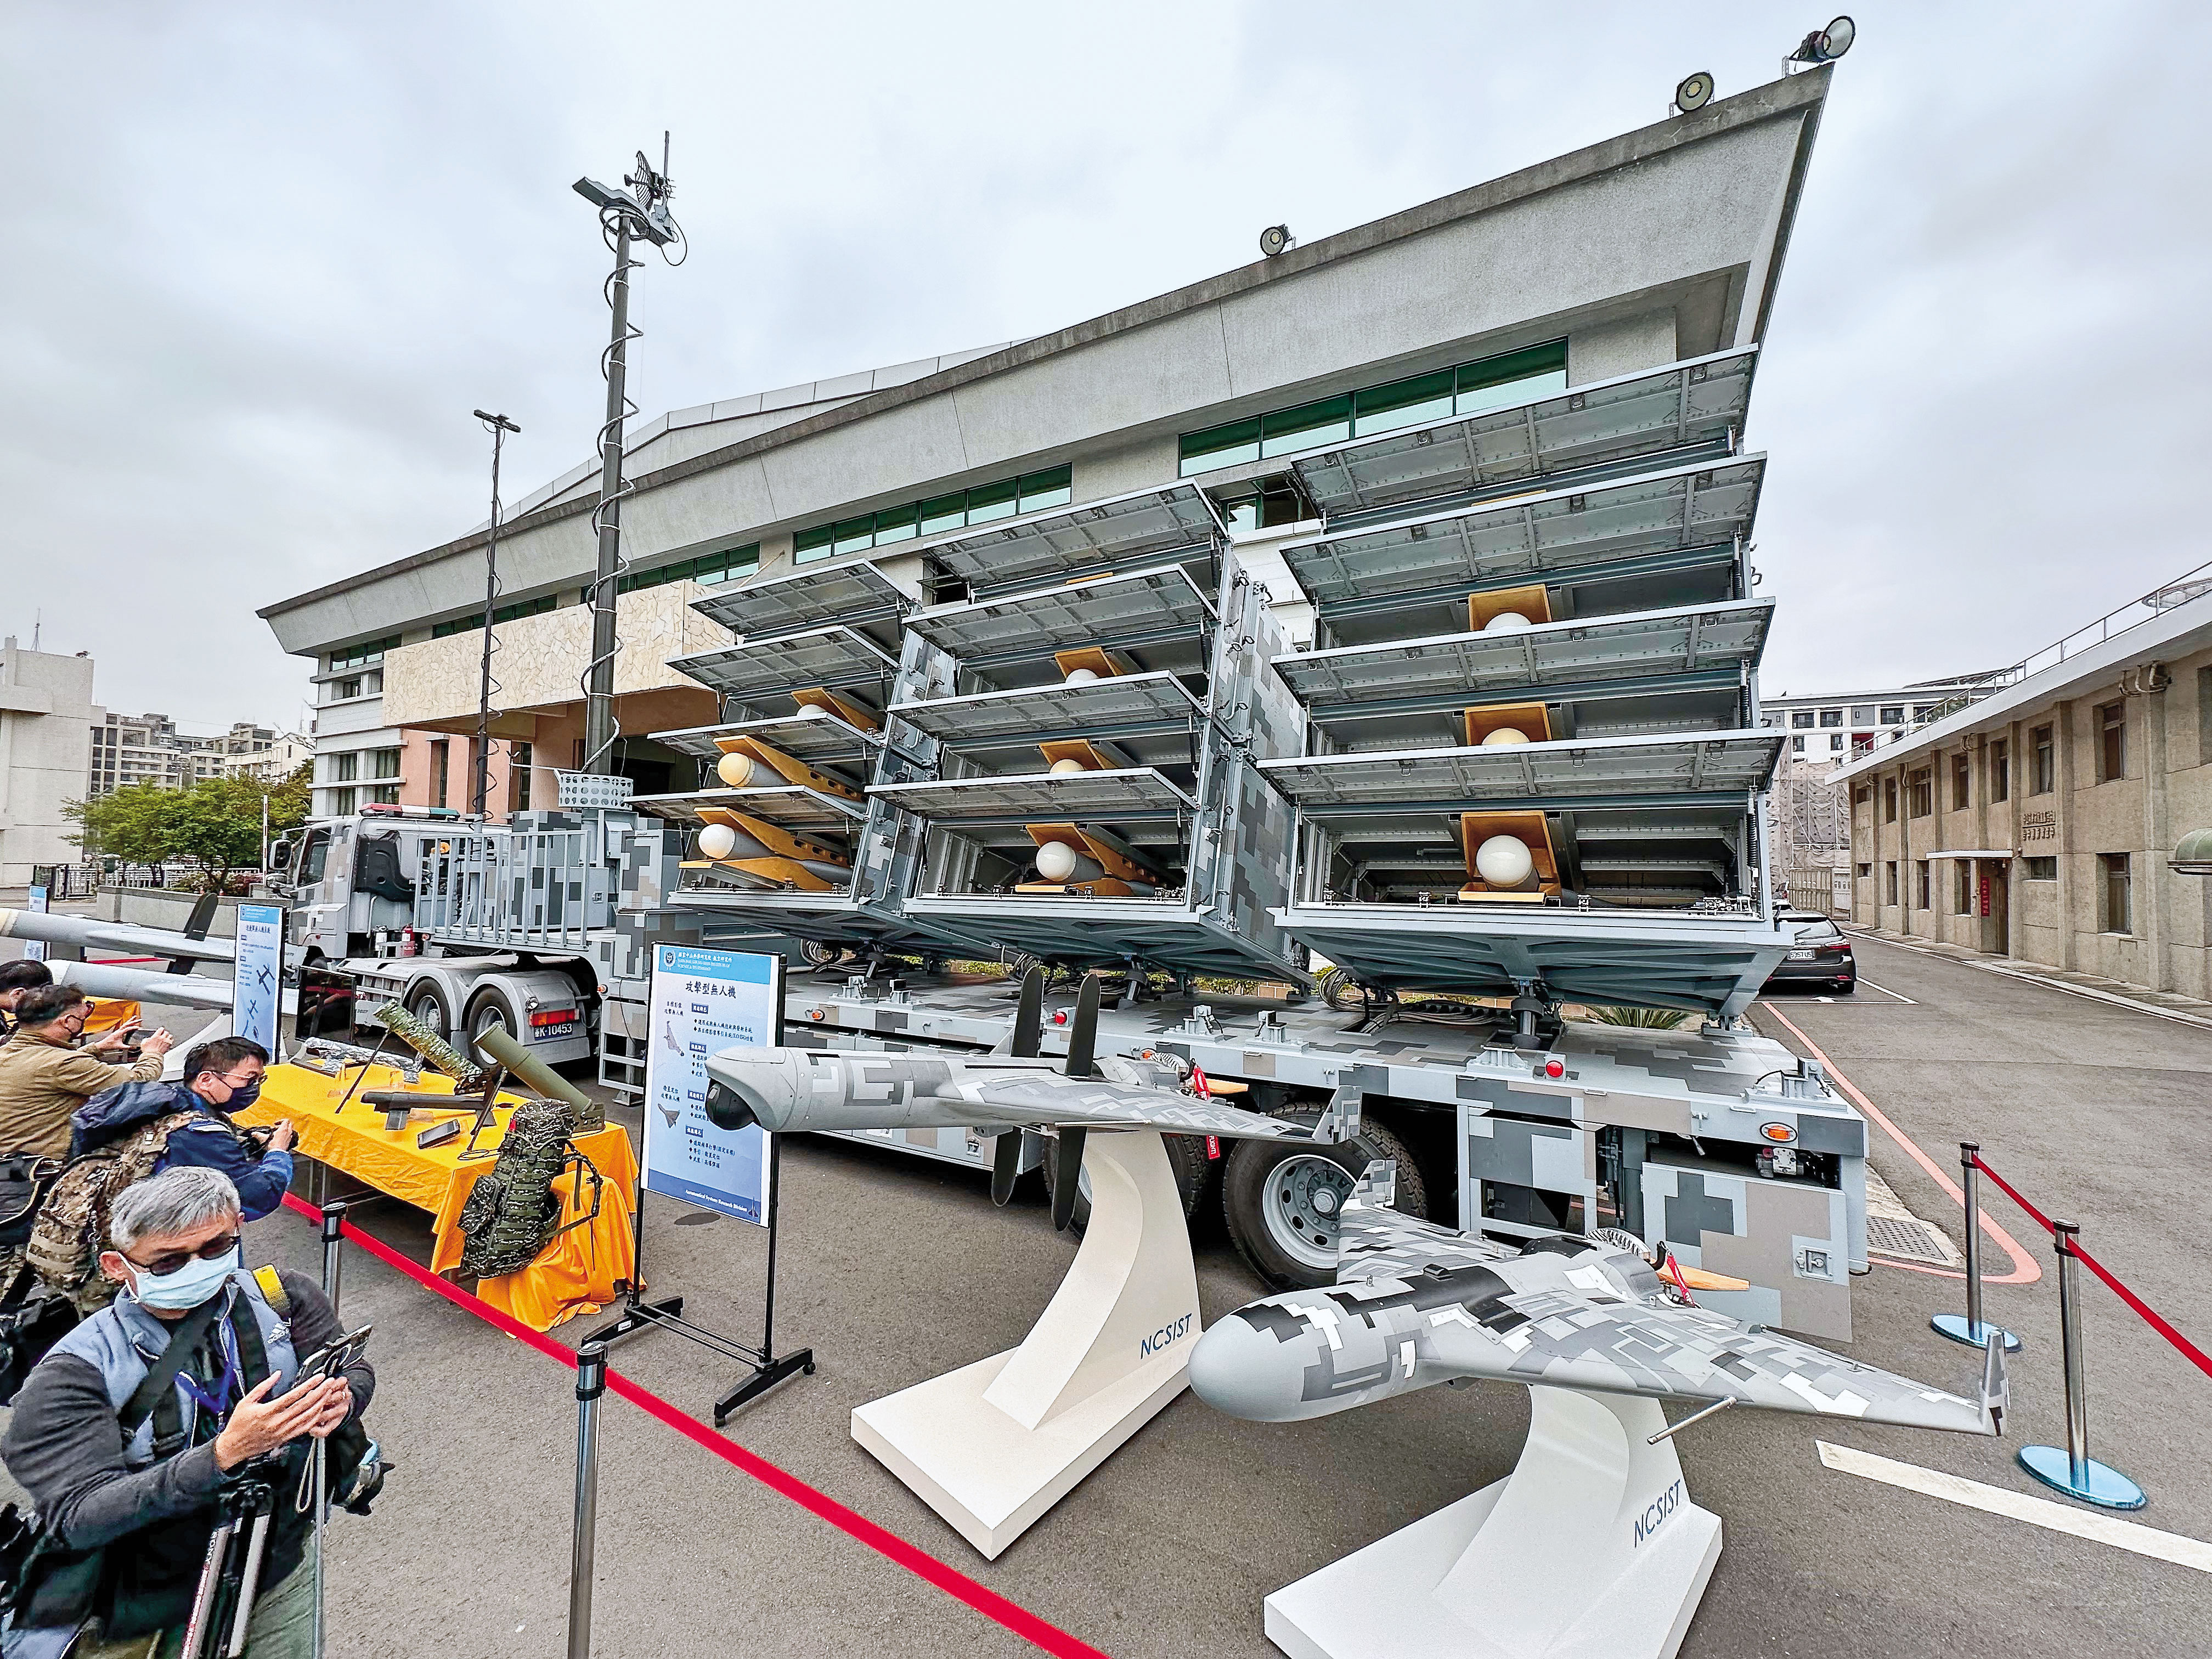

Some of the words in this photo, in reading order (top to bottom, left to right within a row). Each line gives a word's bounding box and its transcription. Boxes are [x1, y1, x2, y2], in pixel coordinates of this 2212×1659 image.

[685, 981, 736, 998] 攻擊型無人機
[1140, 1312, 1192, 1360] NCSIST
[1634, 1479, 1680, 1548] NCSIST
